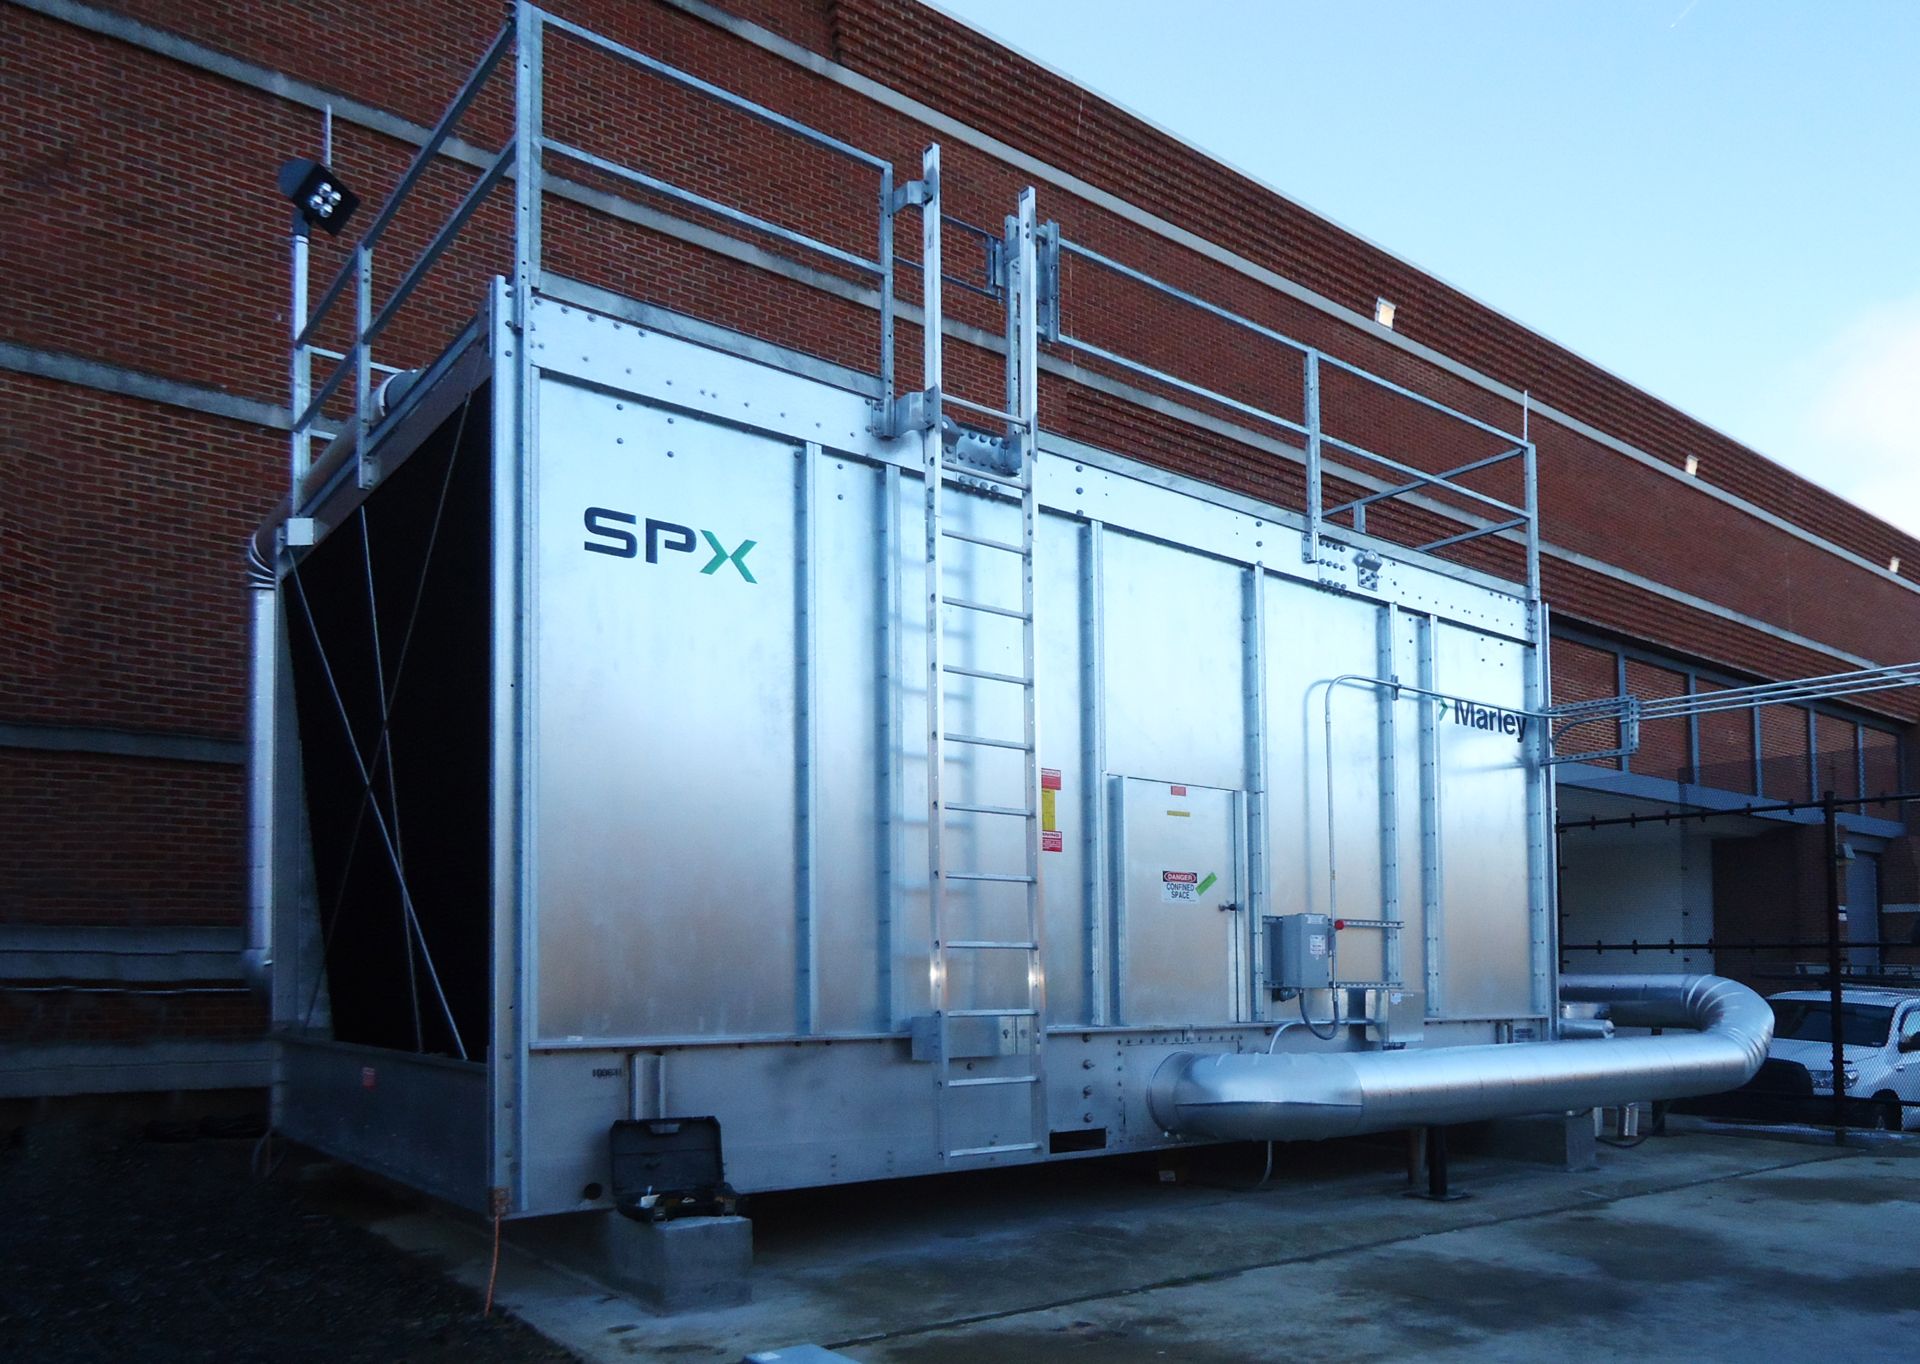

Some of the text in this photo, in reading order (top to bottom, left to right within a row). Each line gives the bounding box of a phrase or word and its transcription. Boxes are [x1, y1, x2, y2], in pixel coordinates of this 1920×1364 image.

[584, 507, 757, 584] SPX
[1454, 700, 1526, 743] Marley
[1167, 873, 1193, 881] DANGER
[1167, 883, 1194, 891] CONFINED
[1171, 891, 1190, 899] SPACE
